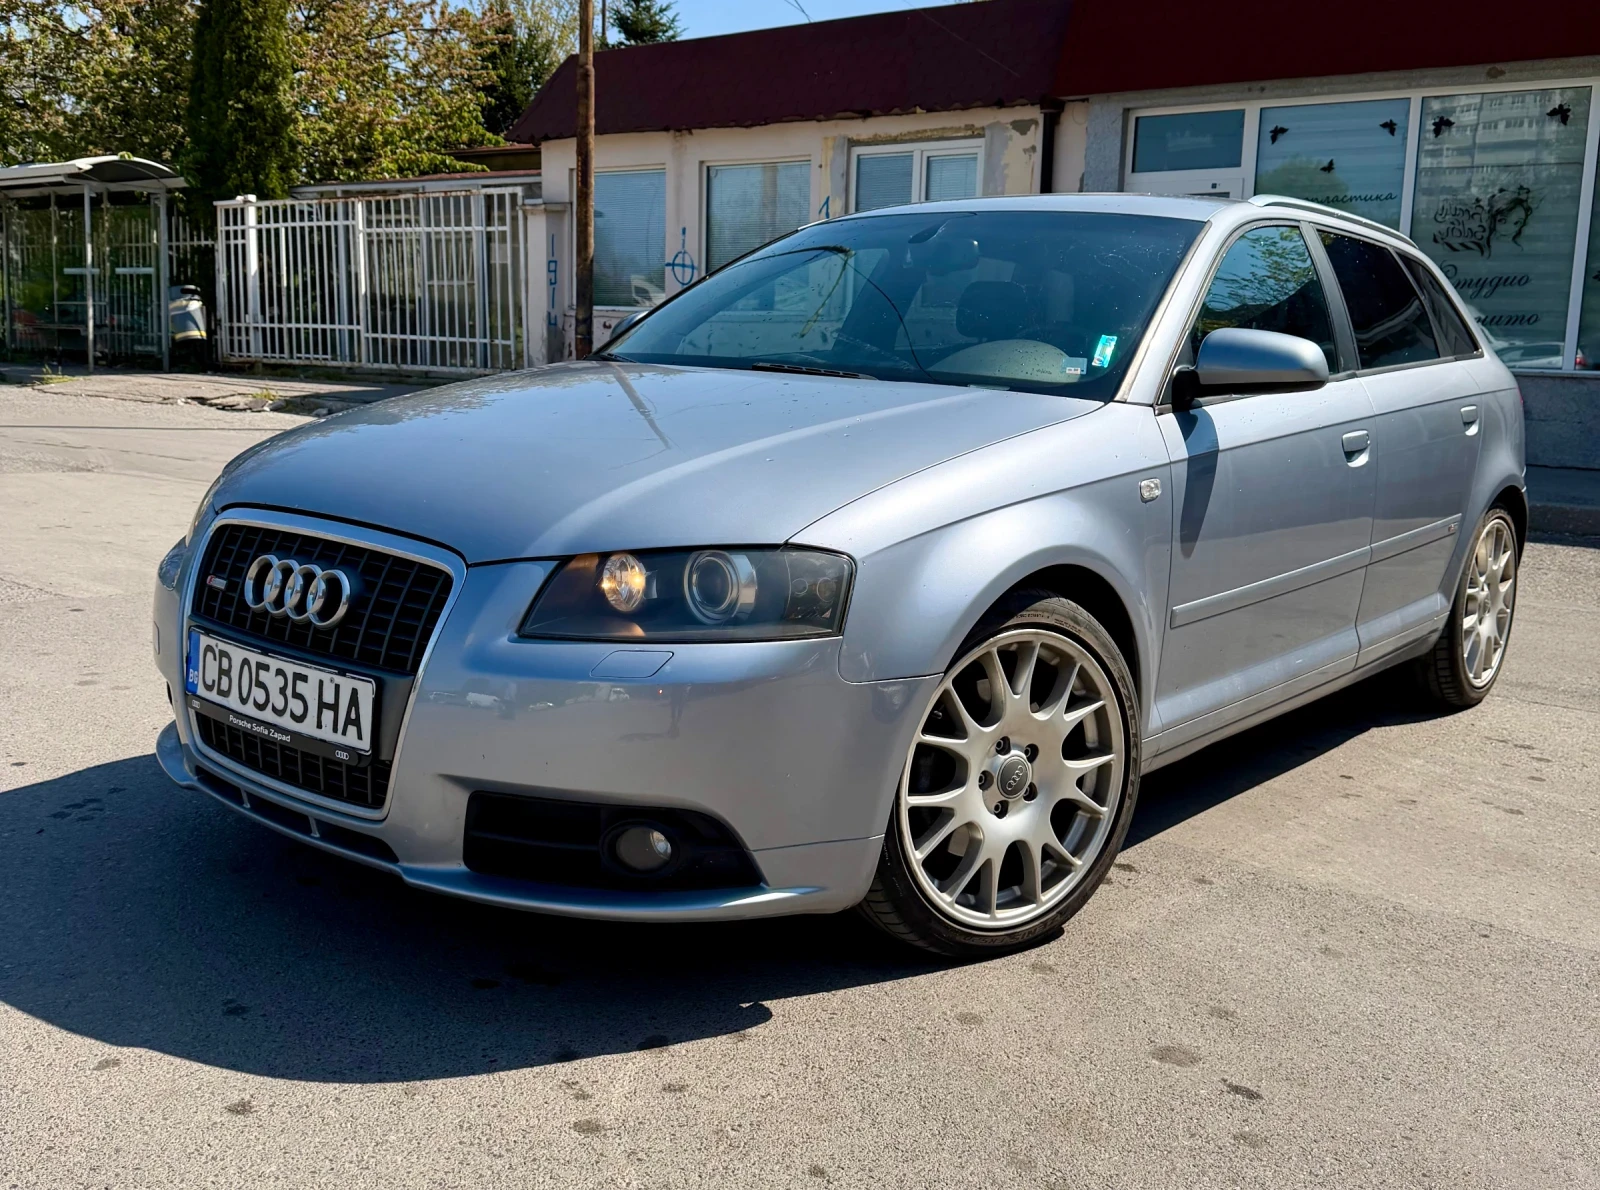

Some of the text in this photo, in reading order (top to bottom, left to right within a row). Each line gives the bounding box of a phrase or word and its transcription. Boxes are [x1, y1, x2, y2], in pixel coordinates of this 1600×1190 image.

[188, 668, 199, 685] BG
[202, 644, 364, 741] CB 0535 HA
[229, 714, 291, 743] Porsche Sofia Zapad
